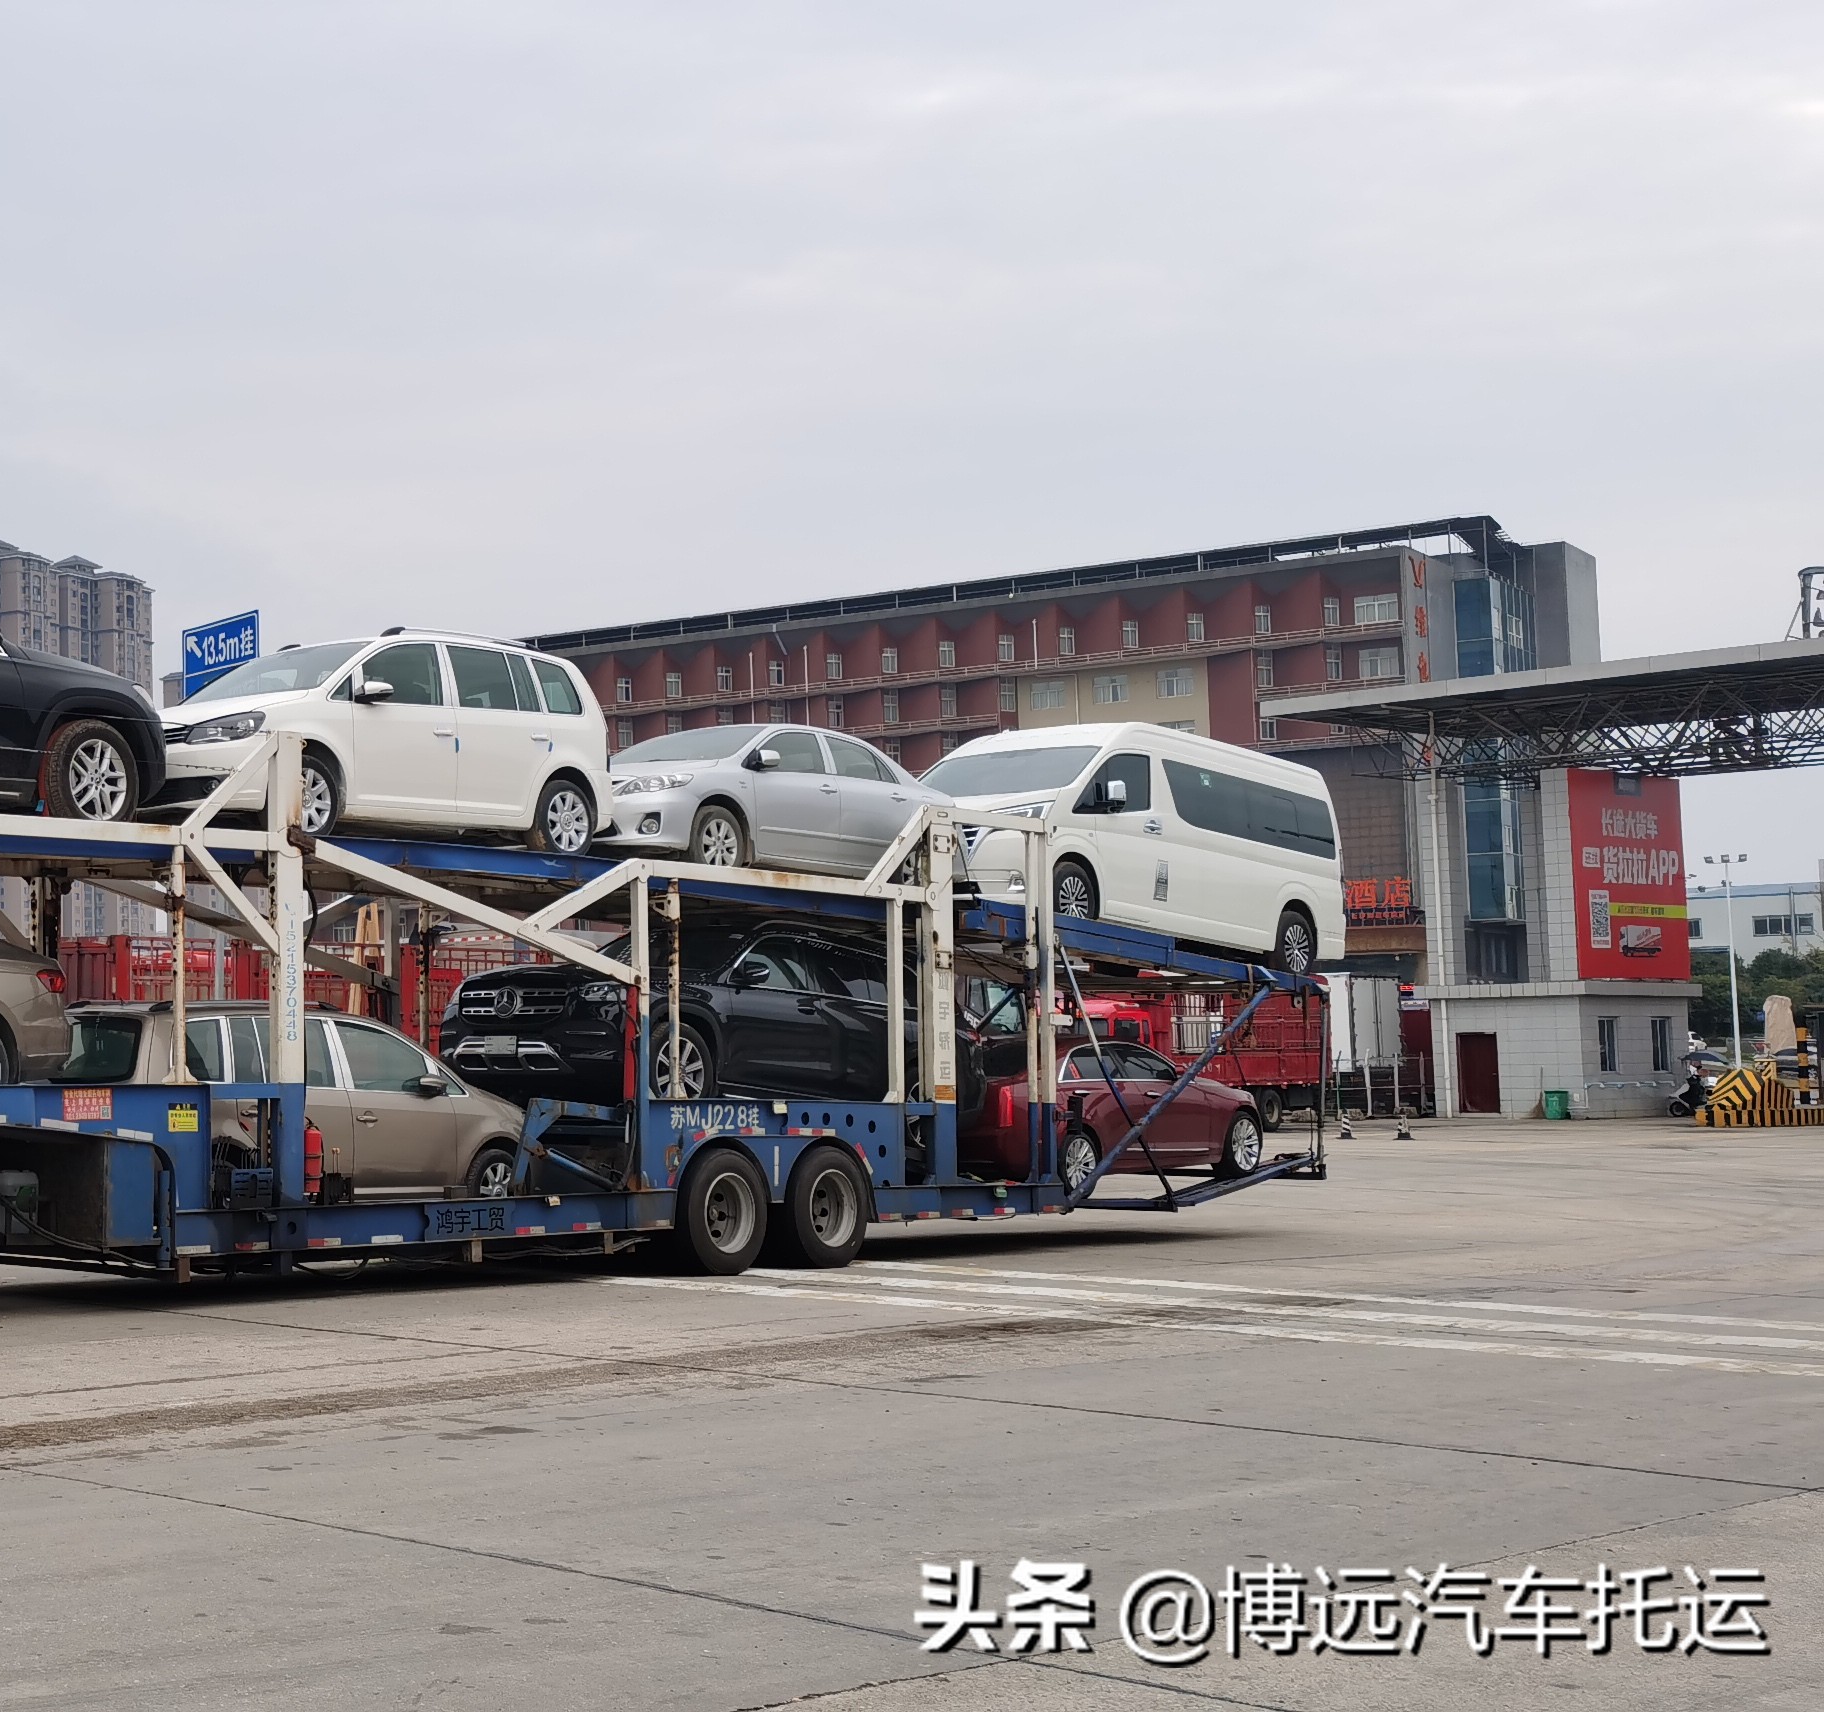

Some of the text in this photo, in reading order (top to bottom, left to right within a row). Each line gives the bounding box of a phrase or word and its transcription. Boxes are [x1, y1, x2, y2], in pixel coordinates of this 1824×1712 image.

[202, 625, 255, 666] 13.5m挂
[1601, 807, 1659, 840] 长途大货车
[1602, 845, 1679, 886] 货拉拉APP
[1344, 876, 1411, 908] 酒店
[670, 1103, 760, 1130] 苏MJ228挂
[436, 1206, 505, 1235] 鸿宇工贸
